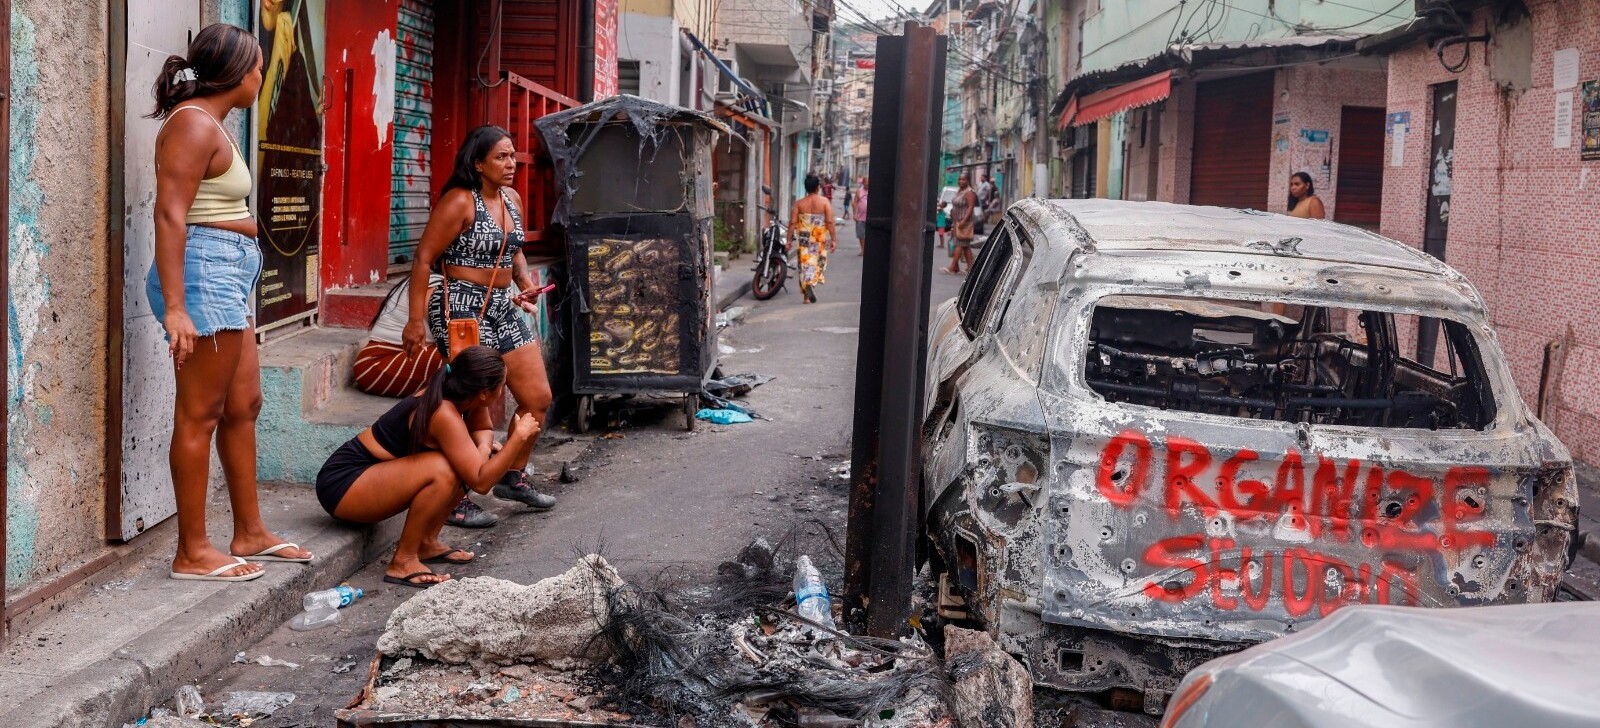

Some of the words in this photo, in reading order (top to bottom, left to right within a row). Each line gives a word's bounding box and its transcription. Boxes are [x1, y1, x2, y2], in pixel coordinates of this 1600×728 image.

[471, 232, 494, 241] LIVES
[455, 292, 486, 308] LIVES
[448, 304, 470, 312] LIVES
[1096, 428, 1496, 552] ORGANIZE
